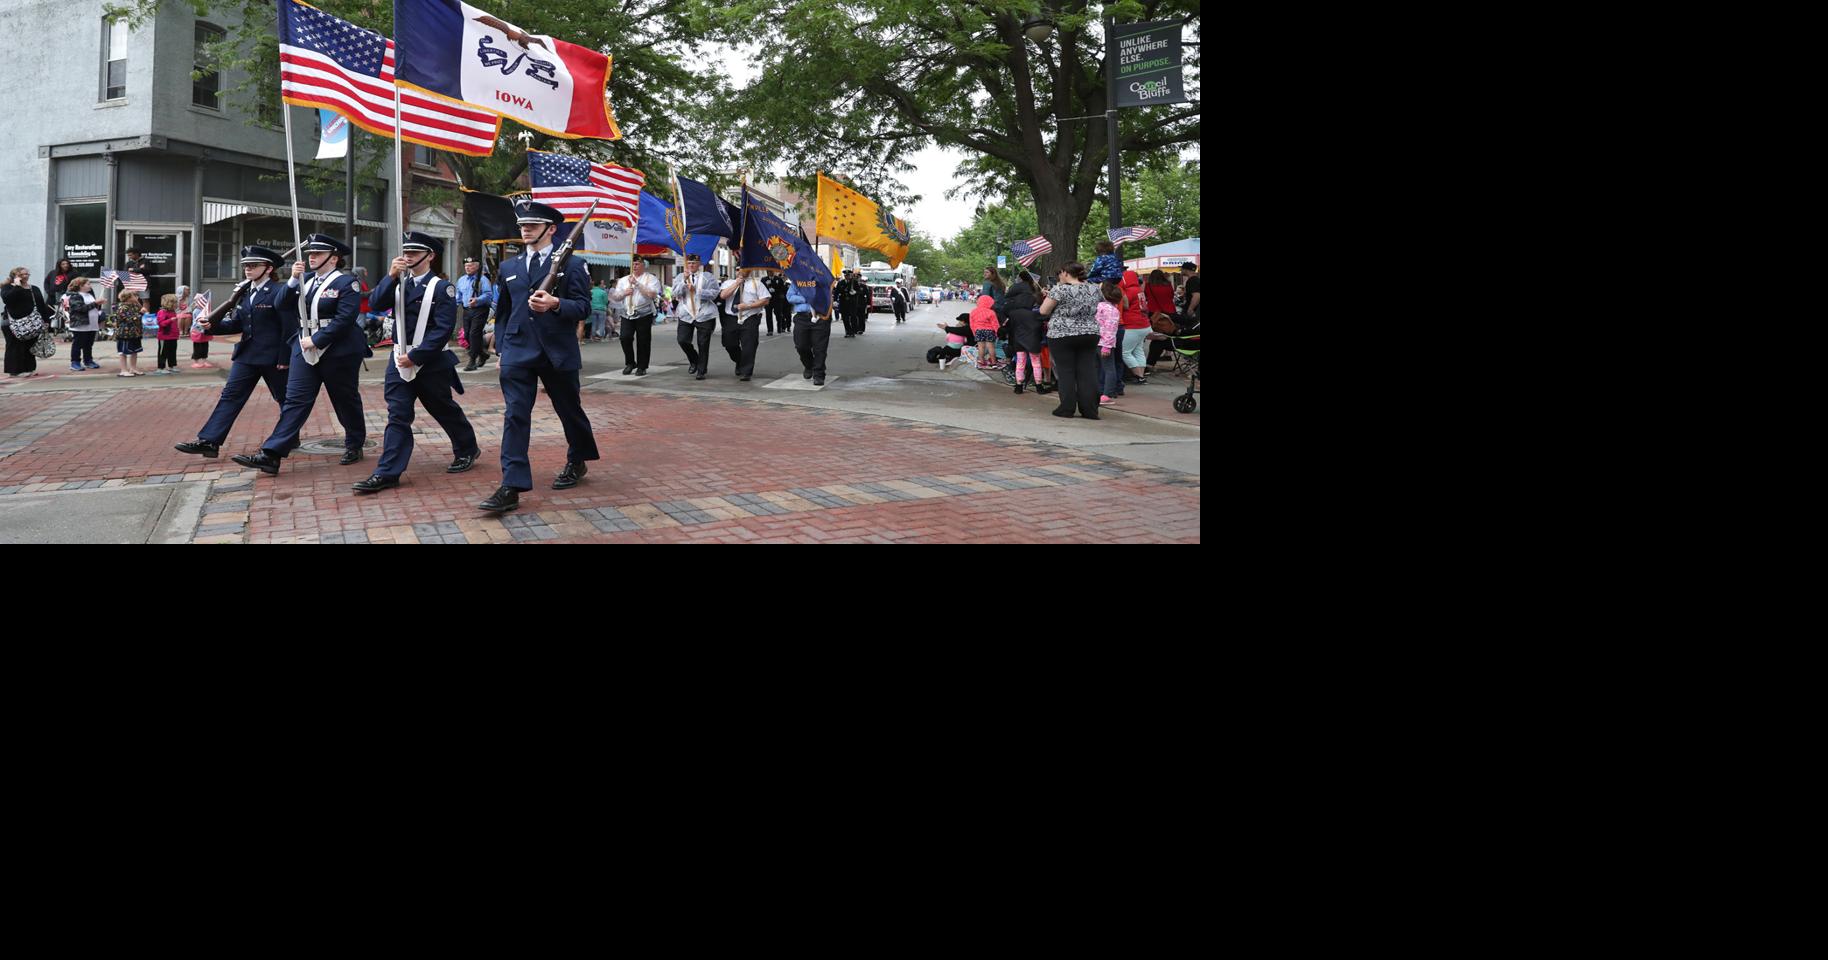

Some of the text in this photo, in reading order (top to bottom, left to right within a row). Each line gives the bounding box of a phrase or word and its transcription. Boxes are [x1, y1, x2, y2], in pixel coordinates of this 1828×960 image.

[1120, 35, 1151, 48] UNLIKE
[1120, 39, 1168, 56] ANYWHERE
[1120, 54, 1143, 65] ELSE.
[1121, 64, 1131, 73] ON
[1129, 76, 1167, 92] Council
[1139, 86, 1171, 100] Bluffs
[496, 89, 533, 111] IOWA
[797, 280, 817, 288] WARS
